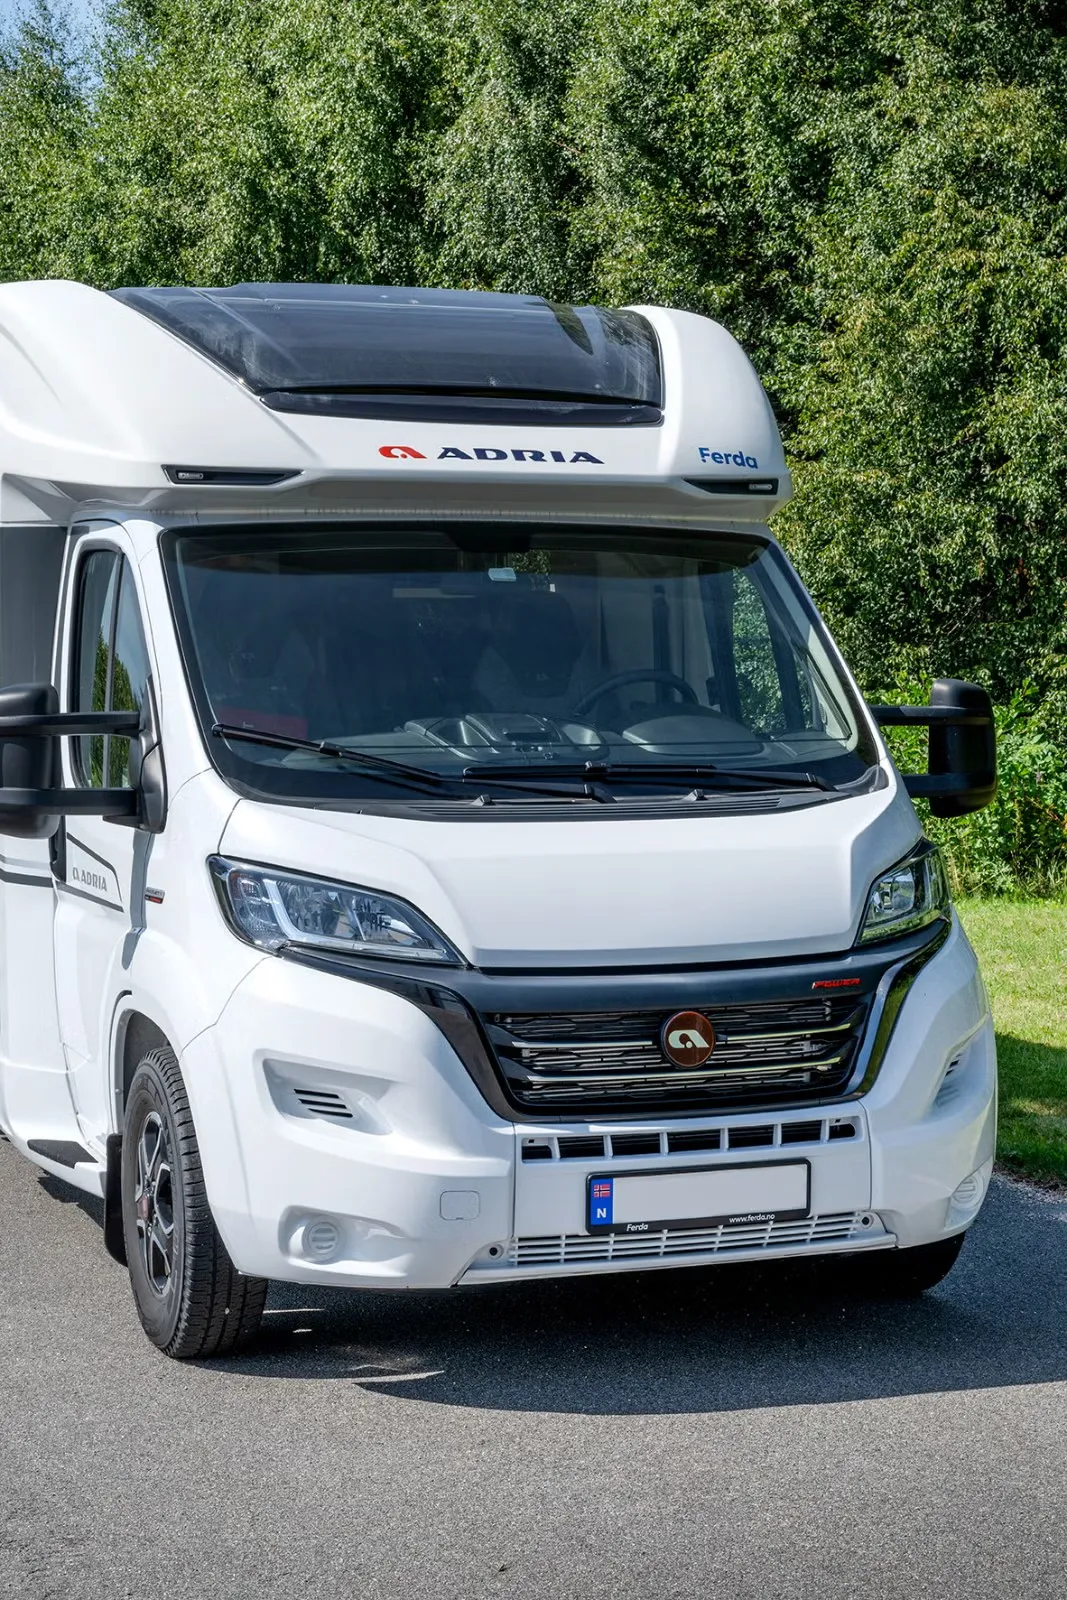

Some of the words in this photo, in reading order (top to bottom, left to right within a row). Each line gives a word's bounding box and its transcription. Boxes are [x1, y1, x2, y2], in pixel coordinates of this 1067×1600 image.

[437, 447, 605, 465] ADRIA
[698, 447, 759, 469] Ferda
[81, 870, 108, 892] ADRIA
[812, 978, 860, 989] POWER
[596, 1208, 607, 1219] N
[728, 1213, 776, 1223] www.ferda.no
[626, 1223, 649, 1232] Ferda
